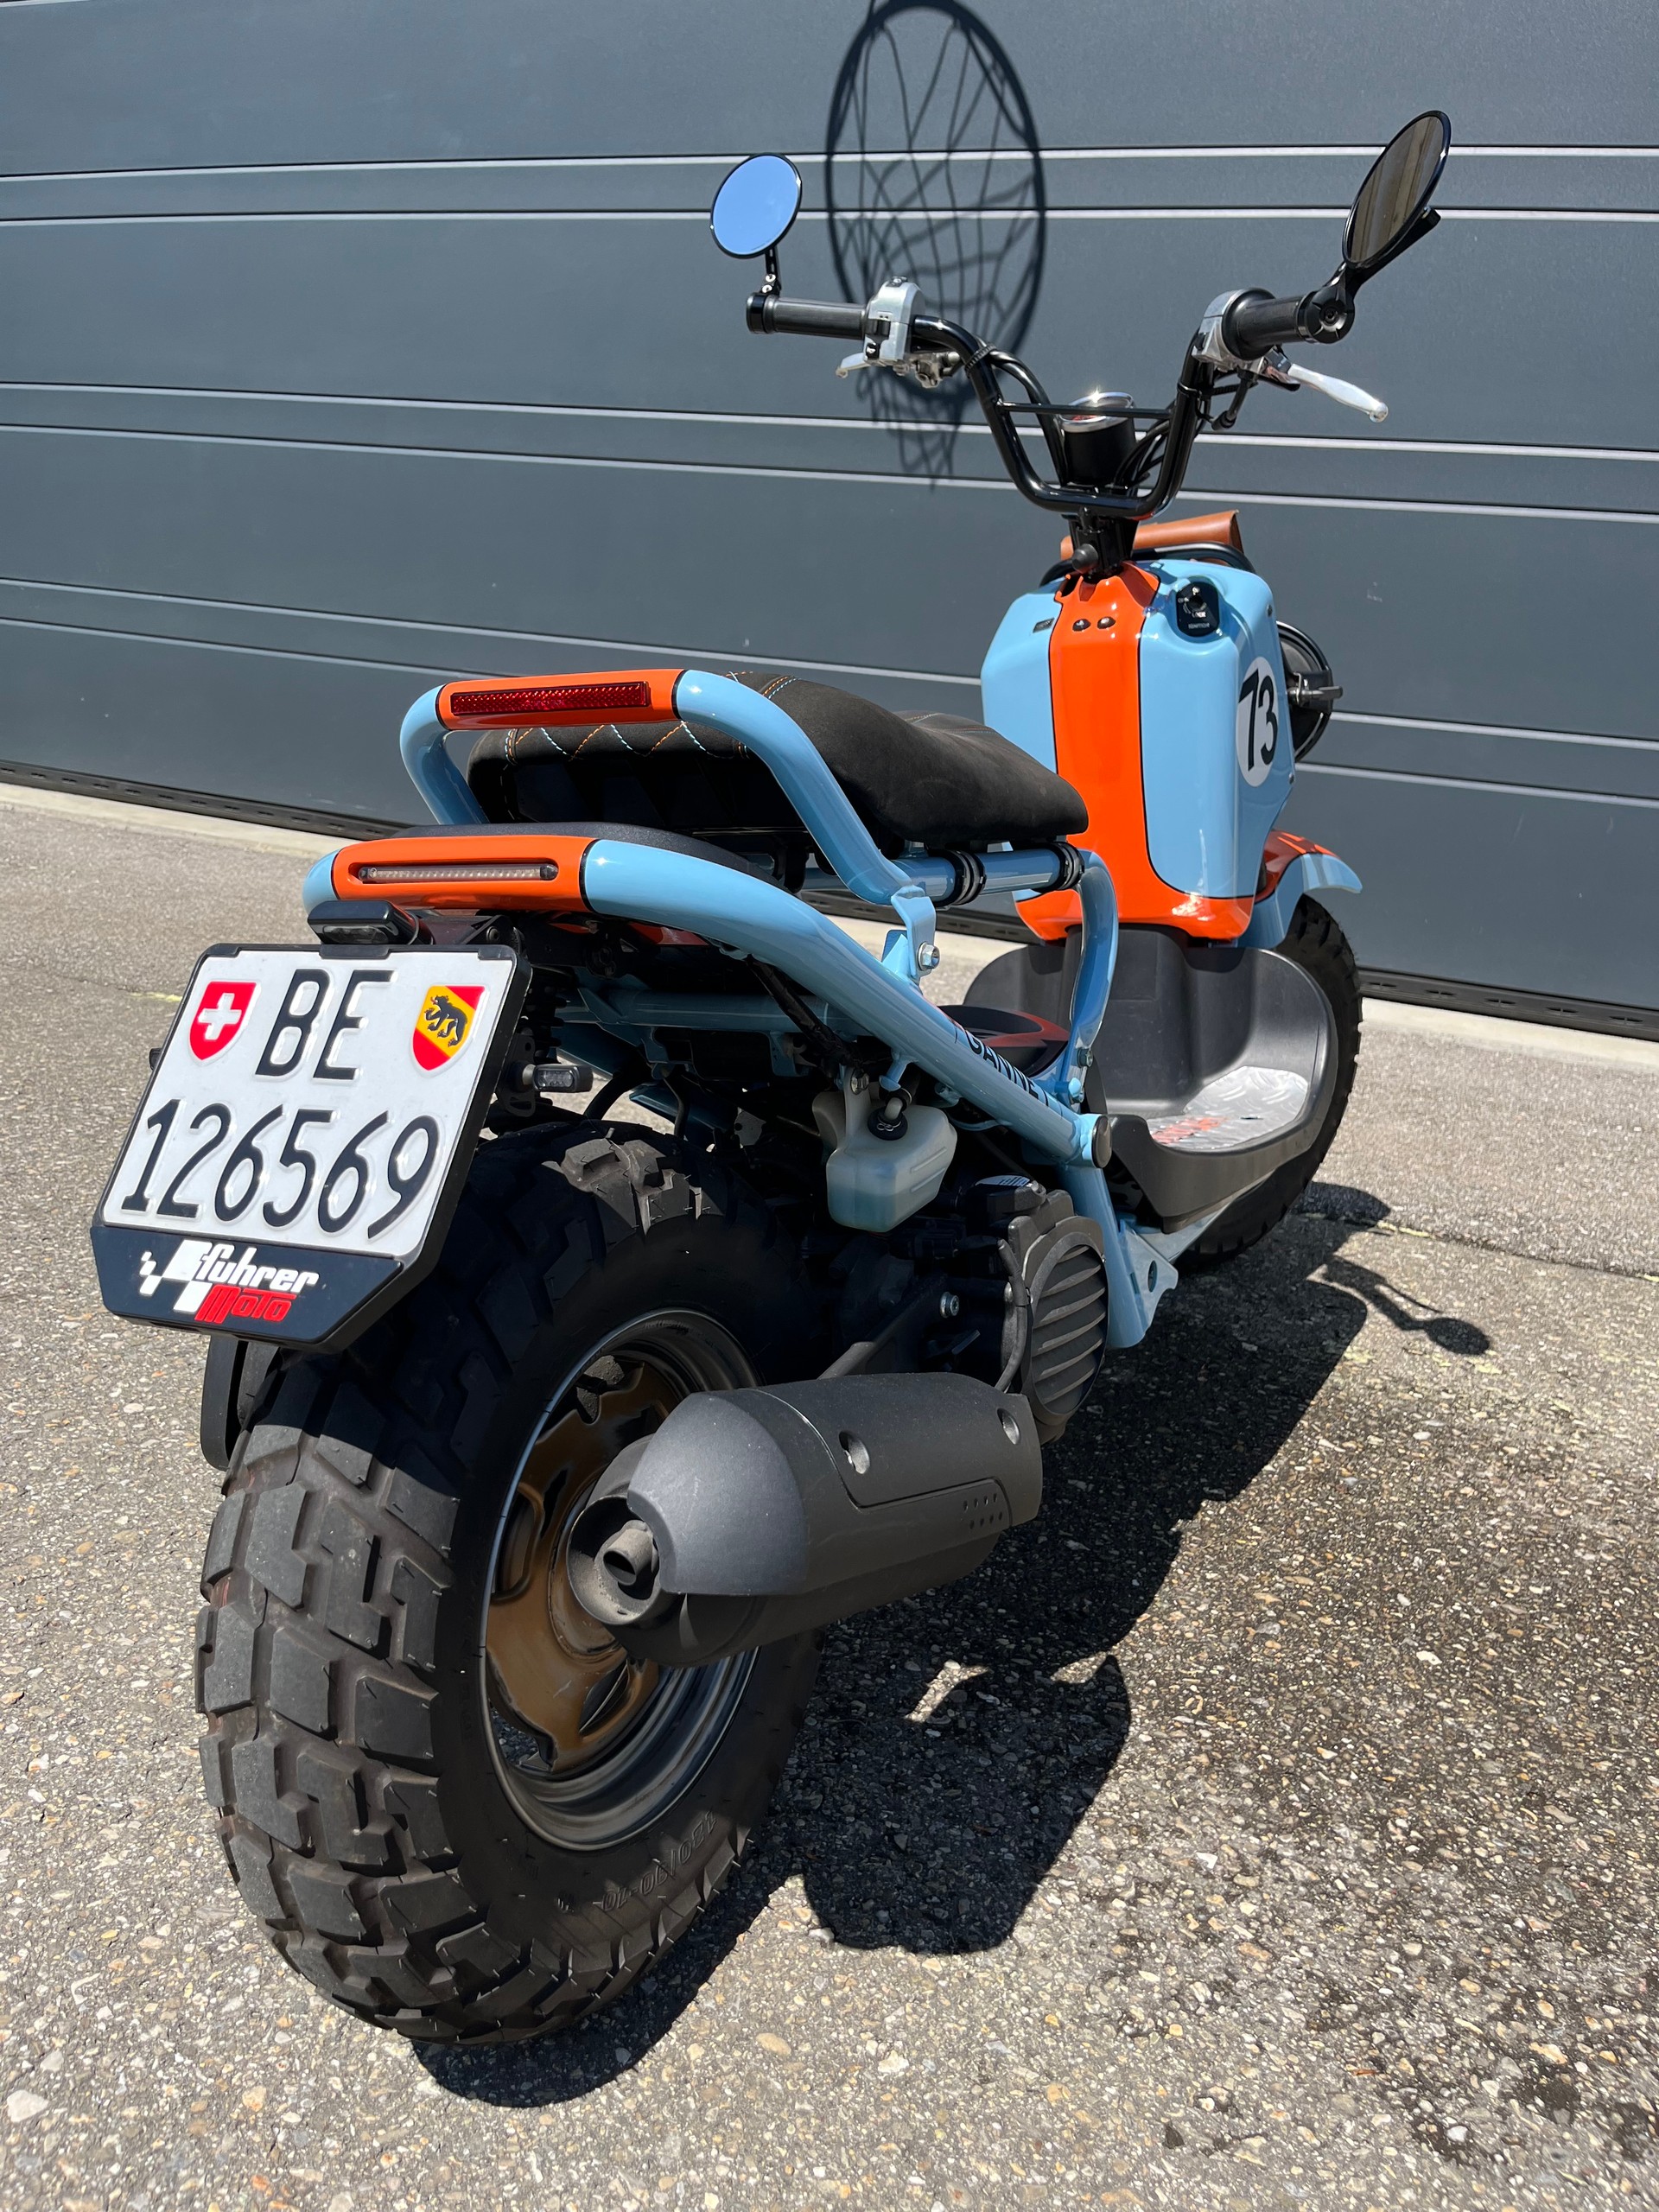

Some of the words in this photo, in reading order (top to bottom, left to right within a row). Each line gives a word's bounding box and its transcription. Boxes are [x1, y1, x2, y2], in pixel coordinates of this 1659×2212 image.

[1238, 669, 1279, 772] 73
[254, 969, 395, 1081] BE
[120, 1098, 441, 1240] 126569
